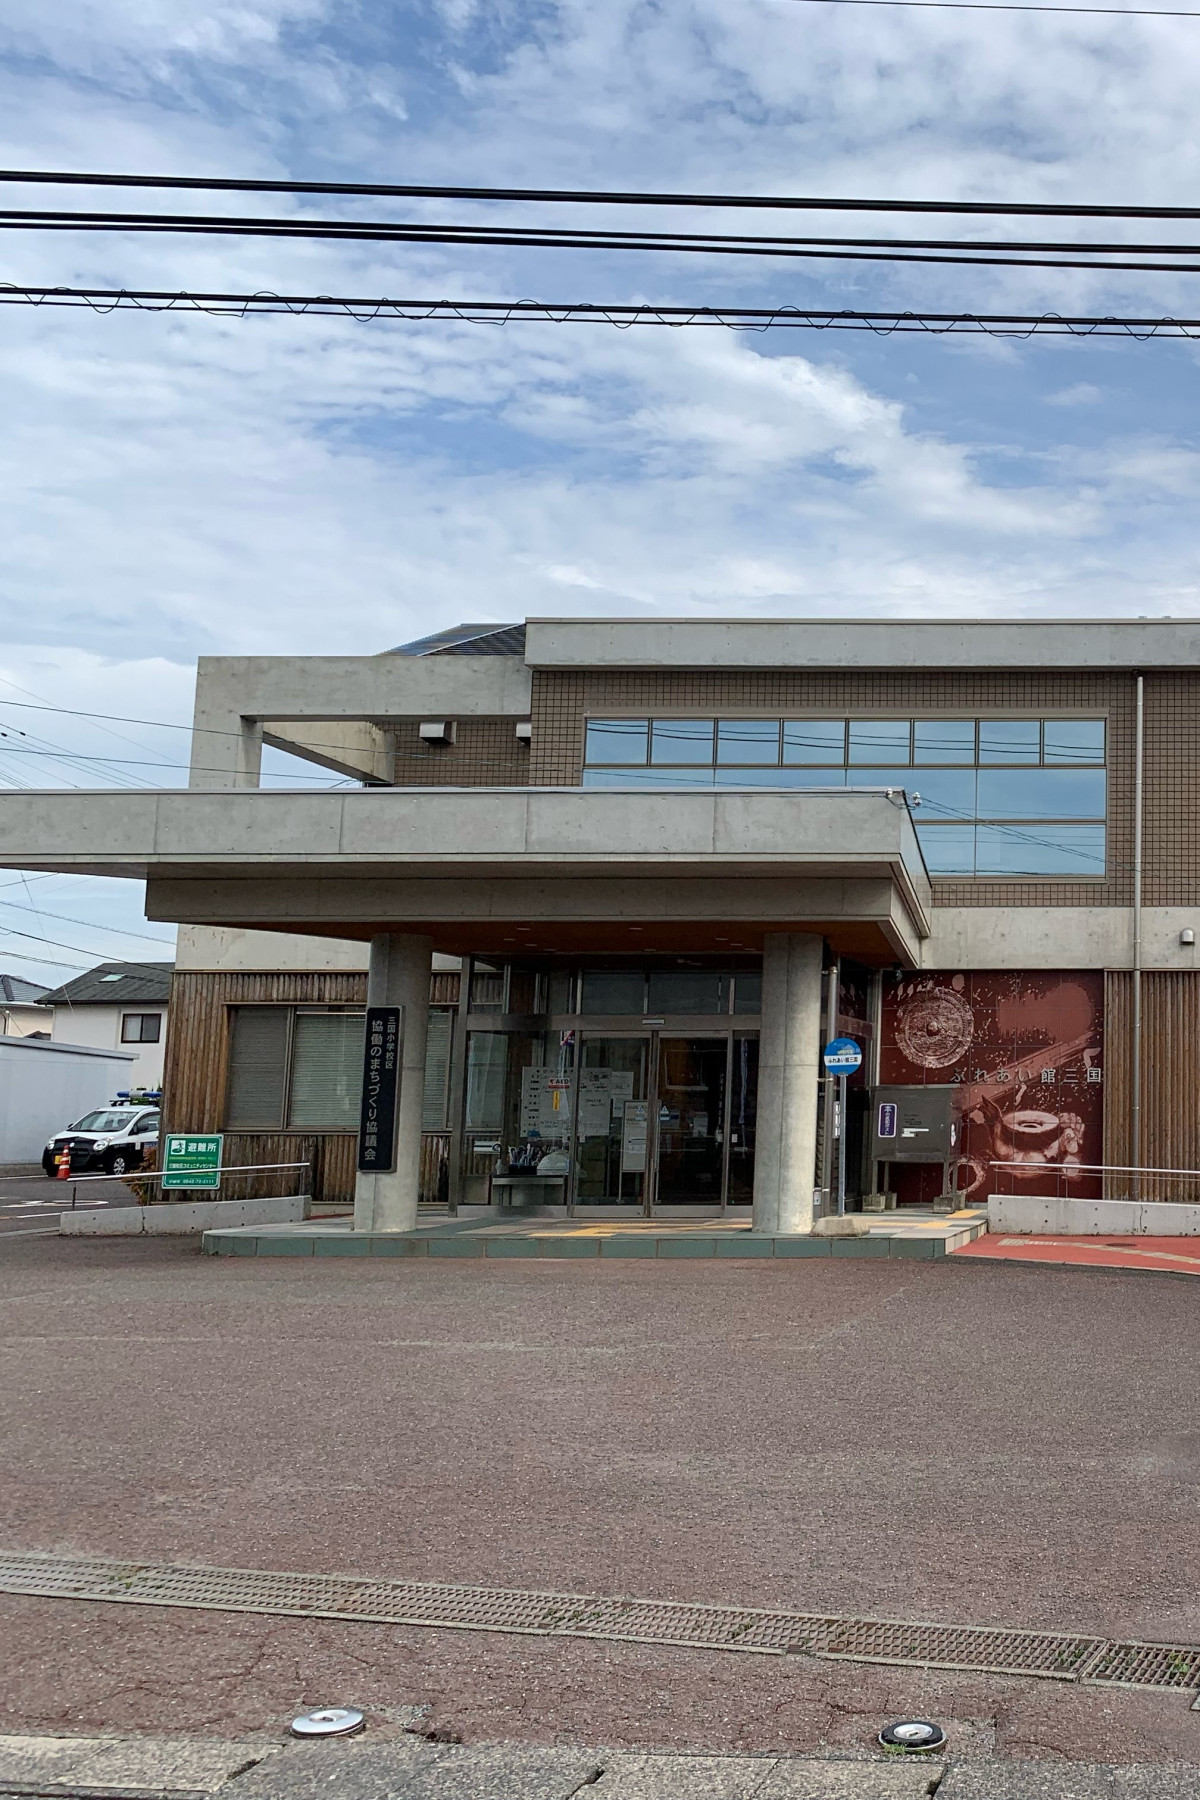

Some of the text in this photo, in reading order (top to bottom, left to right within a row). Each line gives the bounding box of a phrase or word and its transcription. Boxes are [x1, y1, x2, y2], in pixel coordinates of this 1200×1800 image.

[385, 1016, 396, 1069] 三国小学校区
[364, 1019, 384, 1161] 協働のまちづくり協議会
[951, 1066, 1102, 1084] ふれあい館三国
[187, 1142, 217, 1153] 避難所
